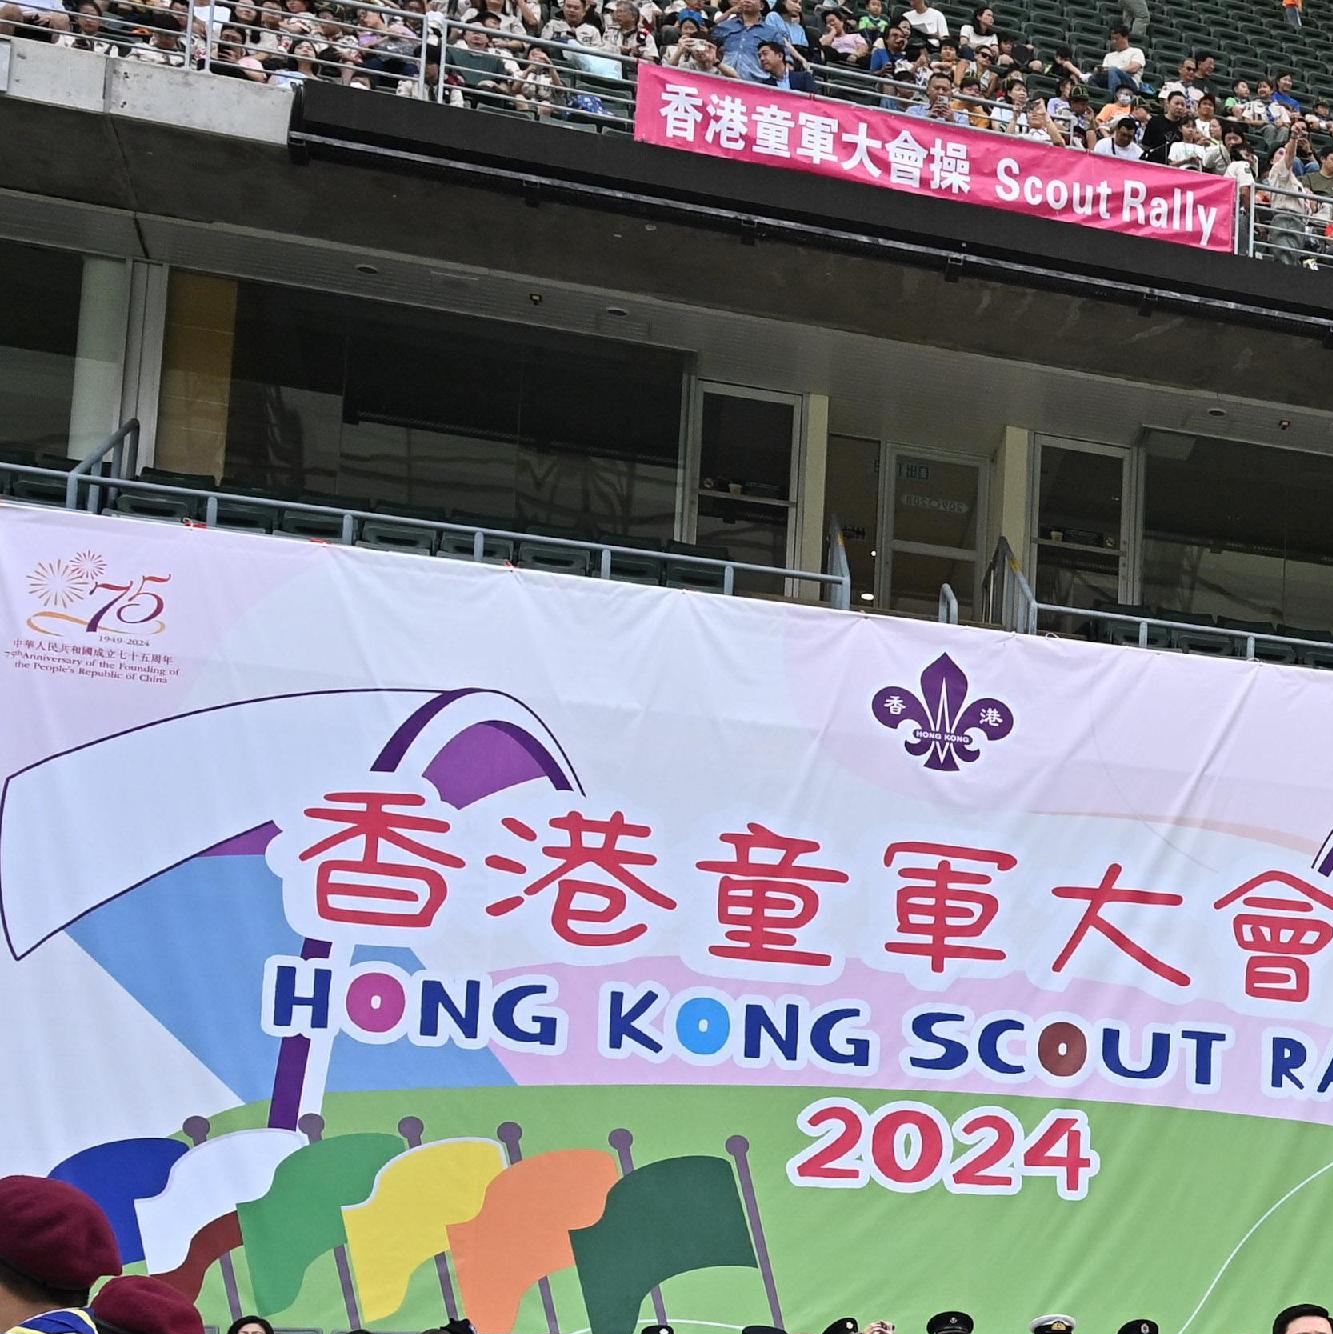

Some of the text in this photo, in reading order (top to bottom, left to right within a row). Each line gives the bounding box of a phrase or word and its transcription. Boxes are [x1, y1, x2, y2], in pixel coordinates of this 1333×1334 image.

[658, 82, 1218, 247] 香港童軍大會操 Scout Rally
[86, 573, 172, 633] 75
[15, 661, 31, 670] the
[33, 662, 75, 675] People's
[78, 667, 123, 680] Republic
[139, 674, 168, 684] China
[100, 660, 116, 670] the
[119, 662, 167, 676] Founding
[884, 695, 907, 715] 香
[979, 707, 1004, 727] 港
[916, 731, 970, 743] HONG KONG
[272, 964, 559, 1047] HONG
[608, 989, 871, 1068] KONG
[909, 1010, 1227, 1086] SCOUT
[797, 1103, 1092, 1193] 2024
